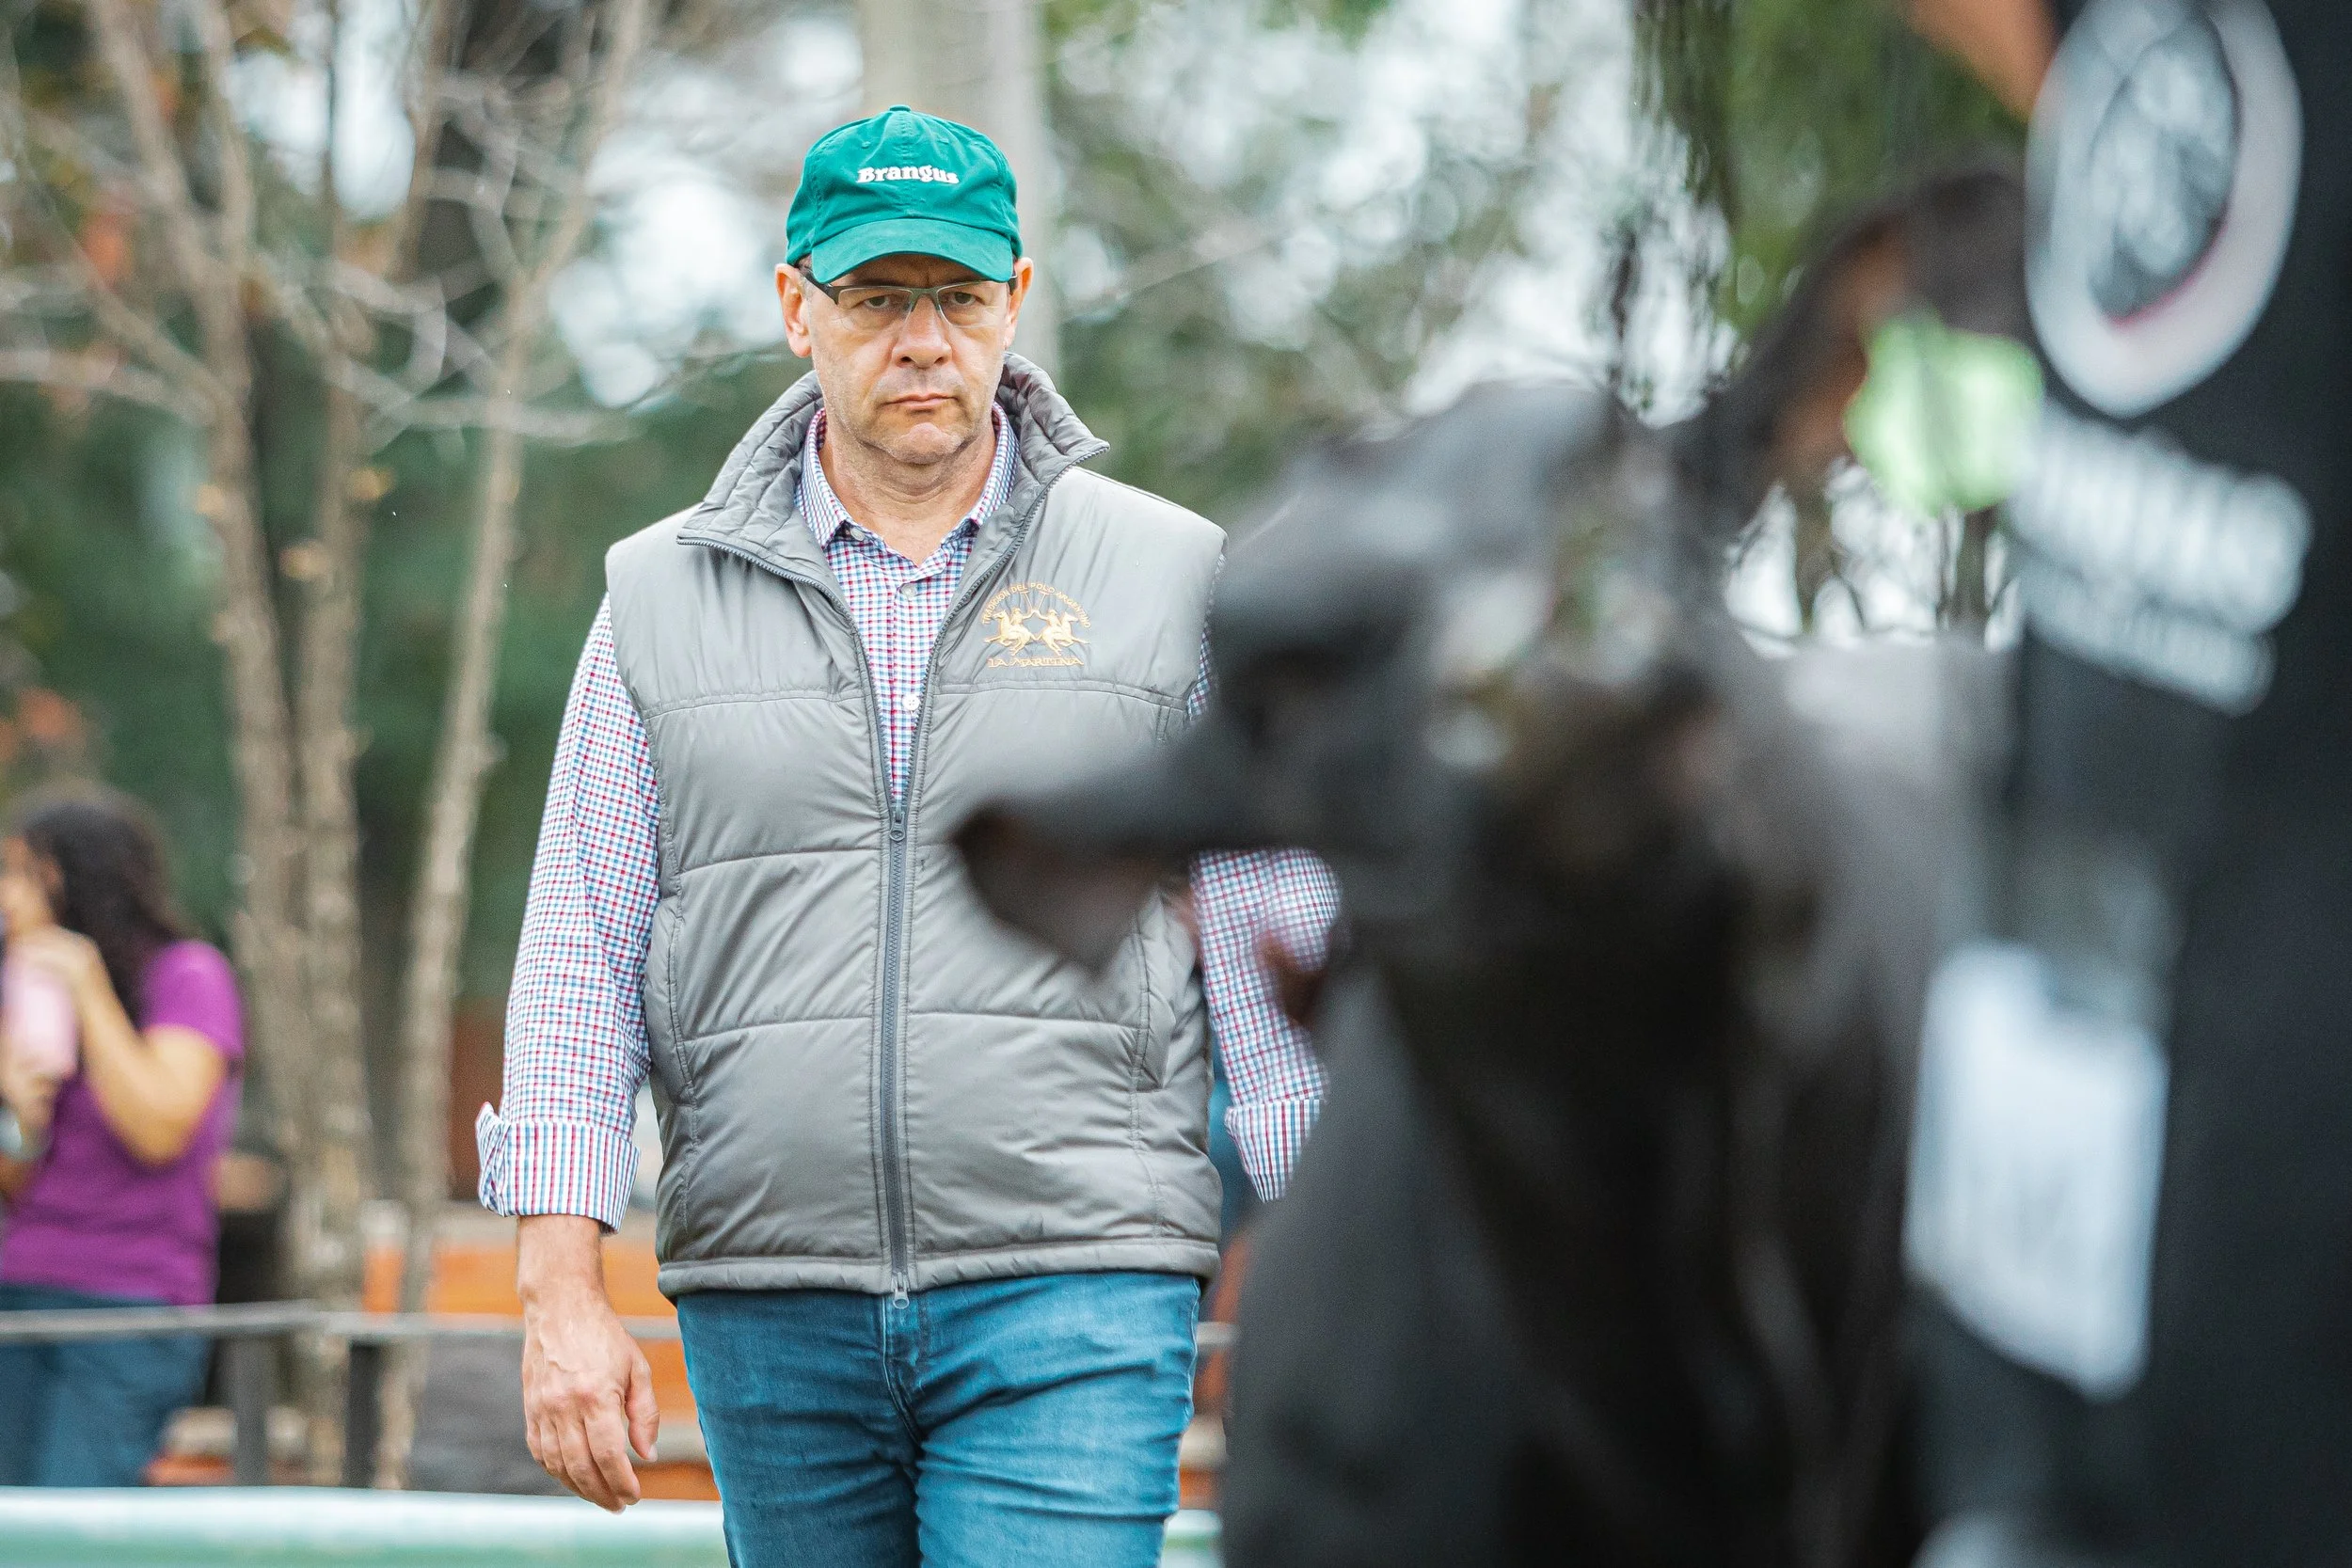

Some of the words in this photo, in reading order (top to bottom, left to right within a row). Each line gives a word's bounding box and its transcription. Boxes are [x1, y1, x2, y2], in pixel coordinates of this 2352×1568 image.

[856, 165, 960, 184] Brangus
[1010, 583, 1028, 594] DEL
[1030, 582, 1056, 594] POLO
[1055, 591, 1091, 628] ARGENTINO
[988, 657, 1009, 668] LA
[1009, 656, 1085, 668] MARTINA
